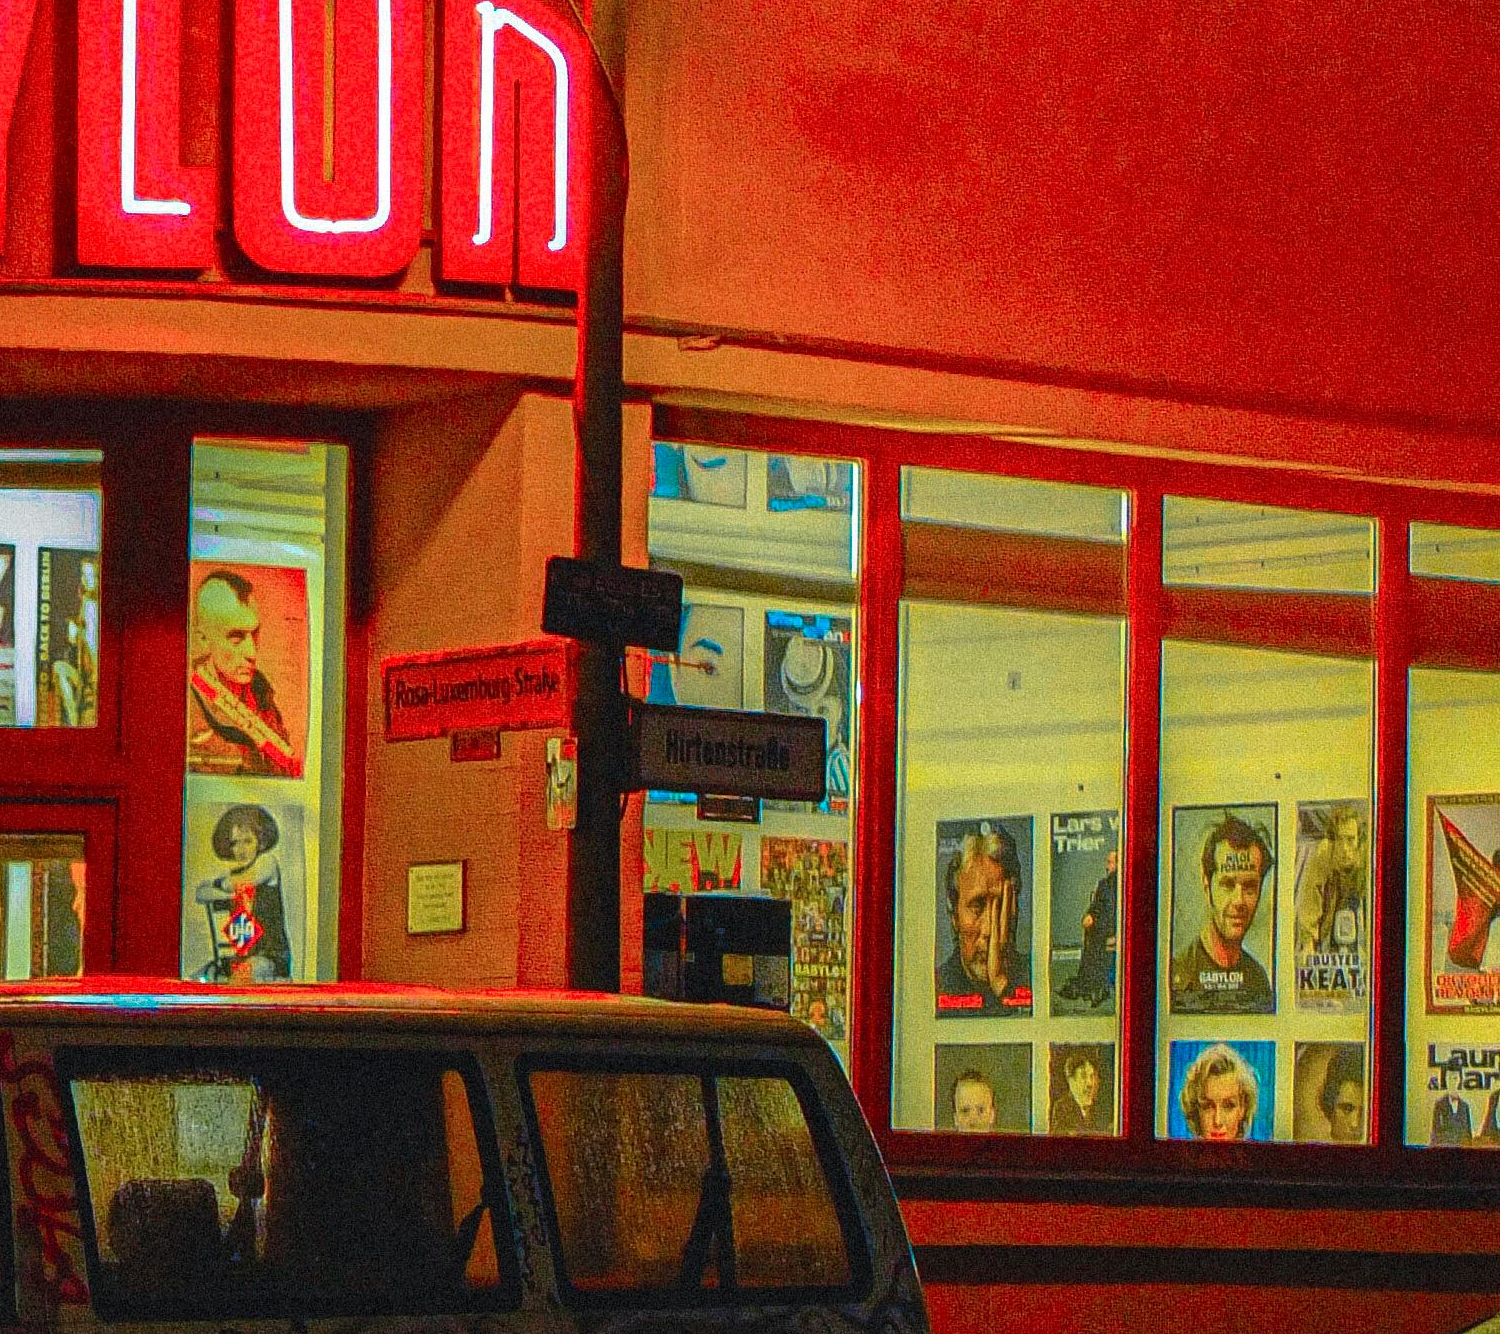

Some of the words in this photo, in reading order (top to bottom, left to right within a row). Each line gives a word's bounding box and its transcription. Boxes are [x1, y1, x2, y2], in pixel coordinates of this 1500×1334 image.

[39, 550, 51, 601] BERLIN
[39, 603, 51, 621] TO
[39, 624, 51, 662] BACK
[664, 728, 791, 770] Hirtenstraße
[1052, 815, 1103, 834] Lars
[1053, 834, 1105, 854] Trier
[1299, 967, 1366, 991] KEAT
